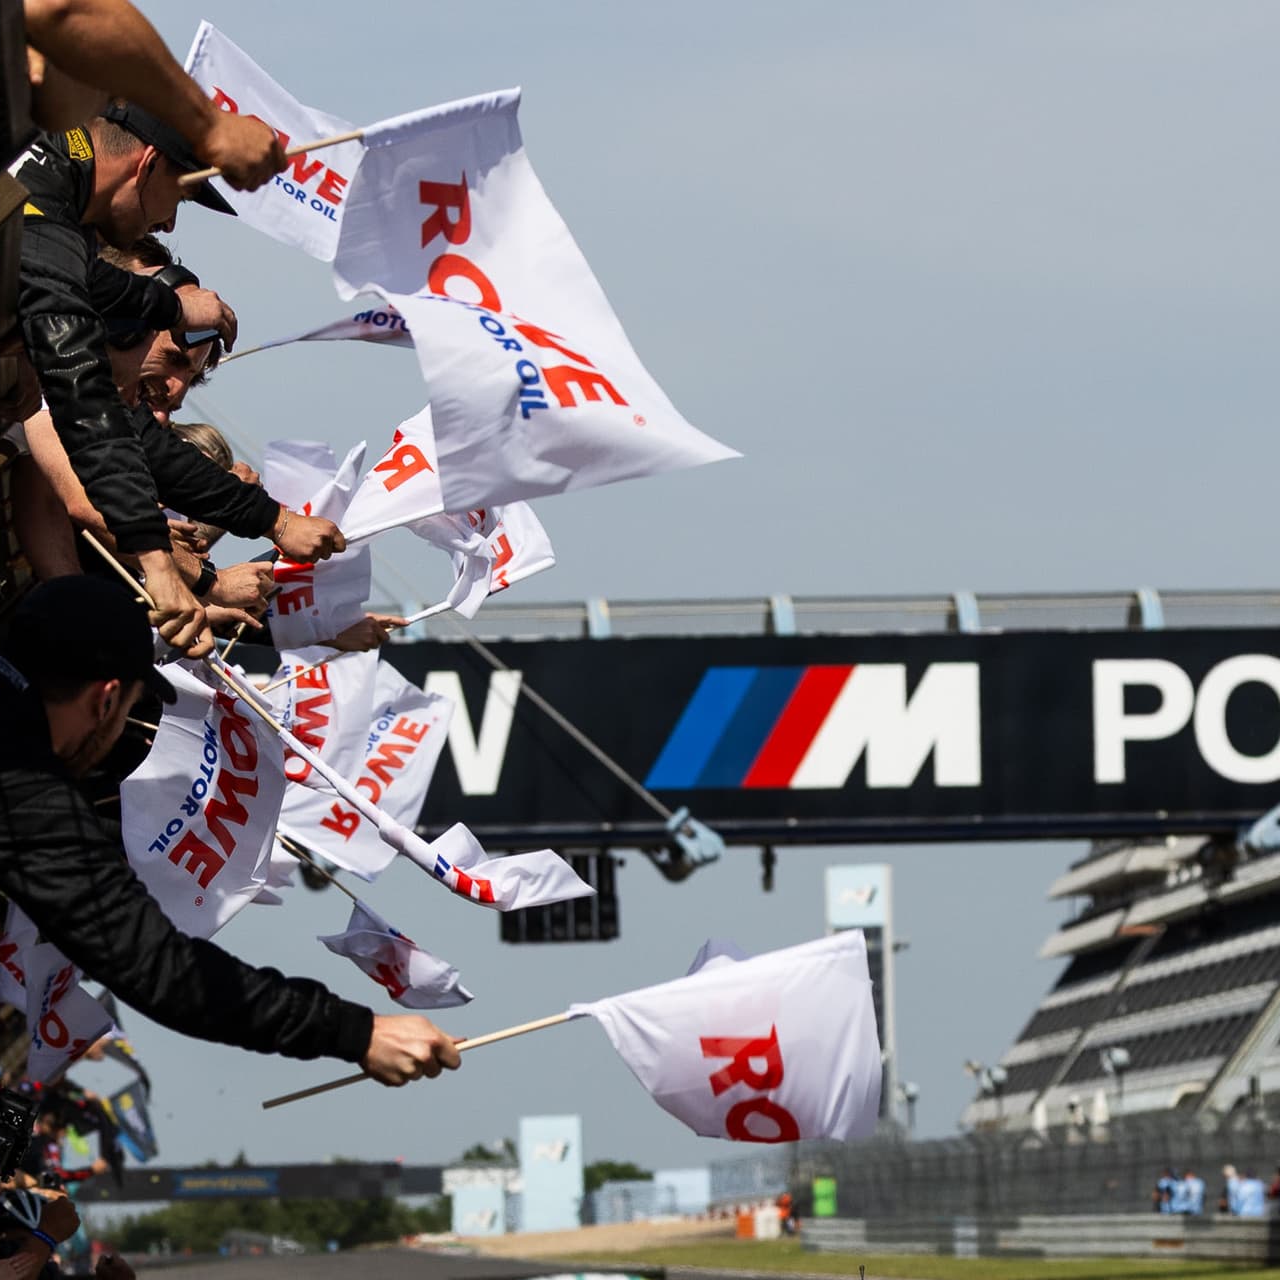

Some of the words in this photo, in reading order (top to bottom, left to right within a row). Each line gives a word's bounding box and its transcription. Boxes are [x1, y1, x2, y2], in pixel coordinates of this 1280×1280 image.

[272, 174, 307, 204] TOR
[310, 199, 338, 222] OIL
[515, 359, 549, 420] OIL
[180, 719, 219, 817] MOTOR
[148, 817, 185, 854] OIL
